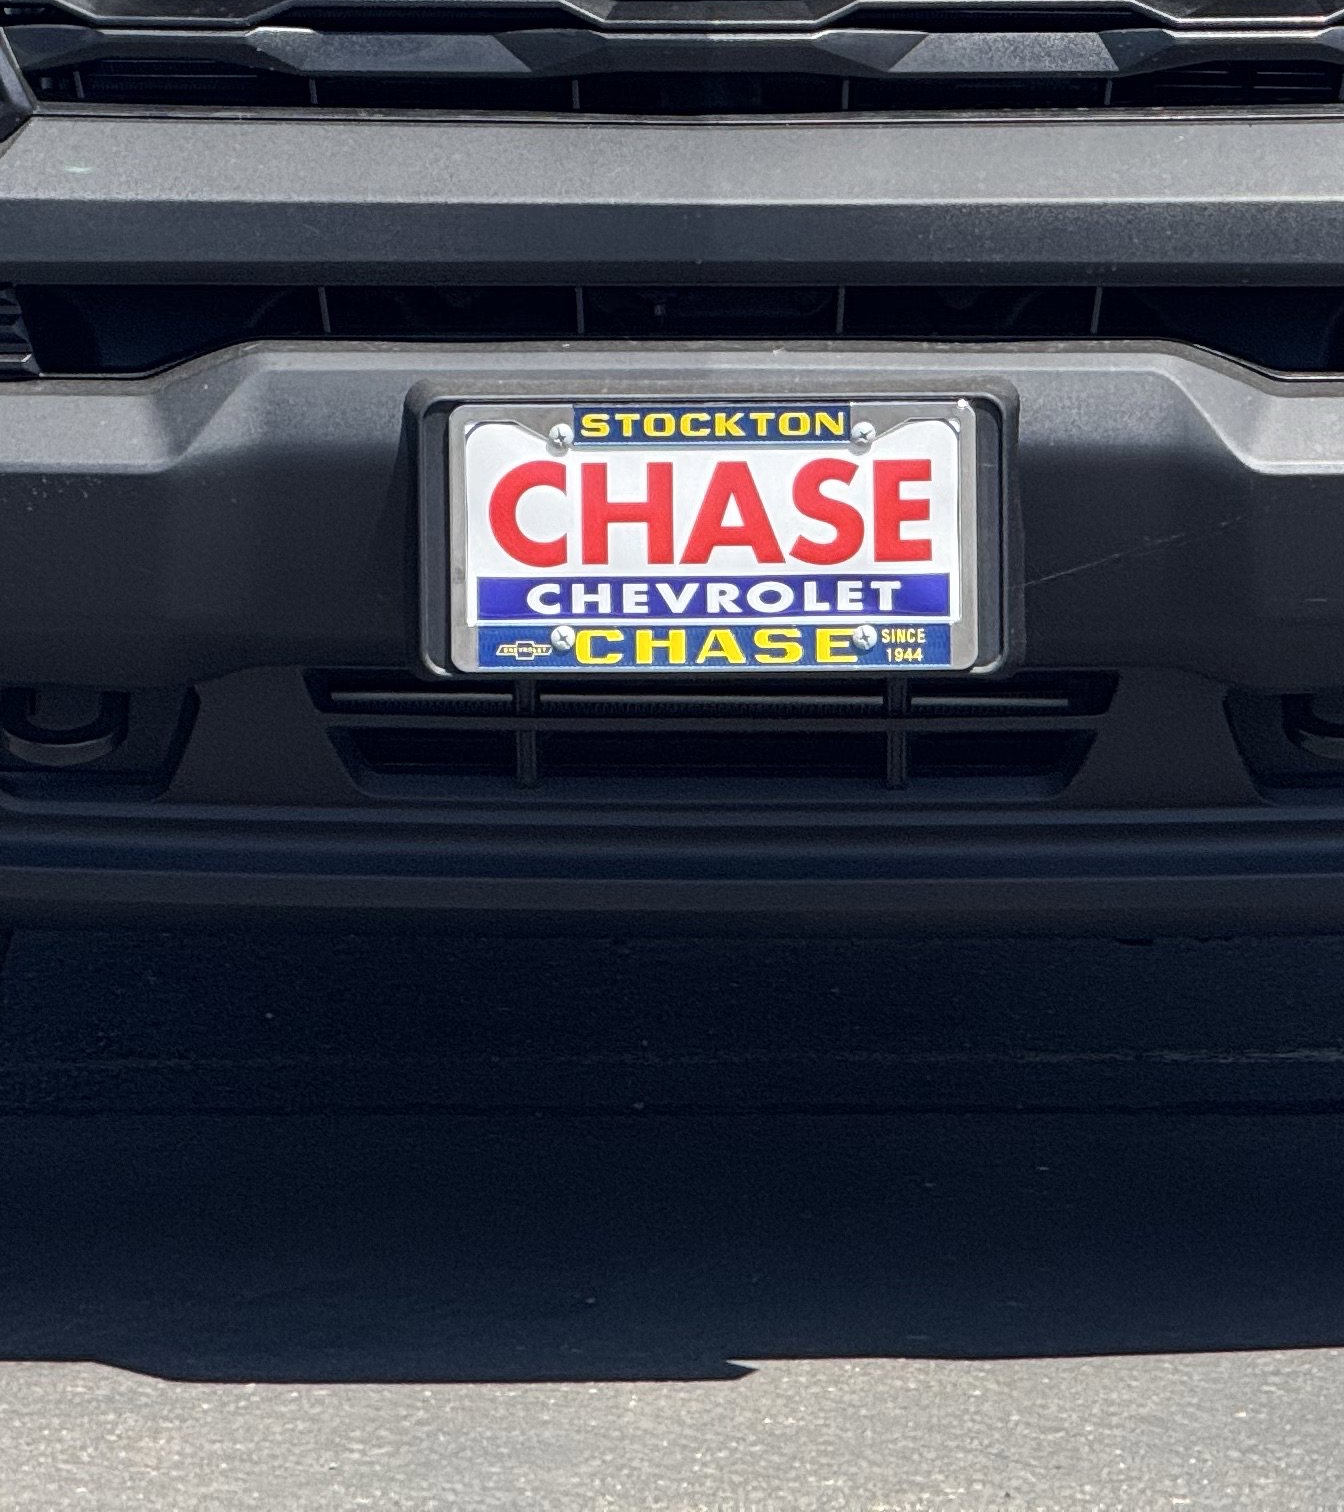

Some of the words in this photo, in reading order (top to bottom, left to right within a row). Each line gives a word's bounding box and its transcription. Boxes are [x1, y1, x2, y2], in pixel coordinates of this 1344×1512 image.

[580, 411, 845, 438] STOCKTON
[488, 457, 933, 568] CHASE
[526, 580, 902, 615] CHEVROLET
[575, 627, 859, 665] CHASE
[881, 628, 926, 644] SINCE
[886, 647, 923, 662] 1944
